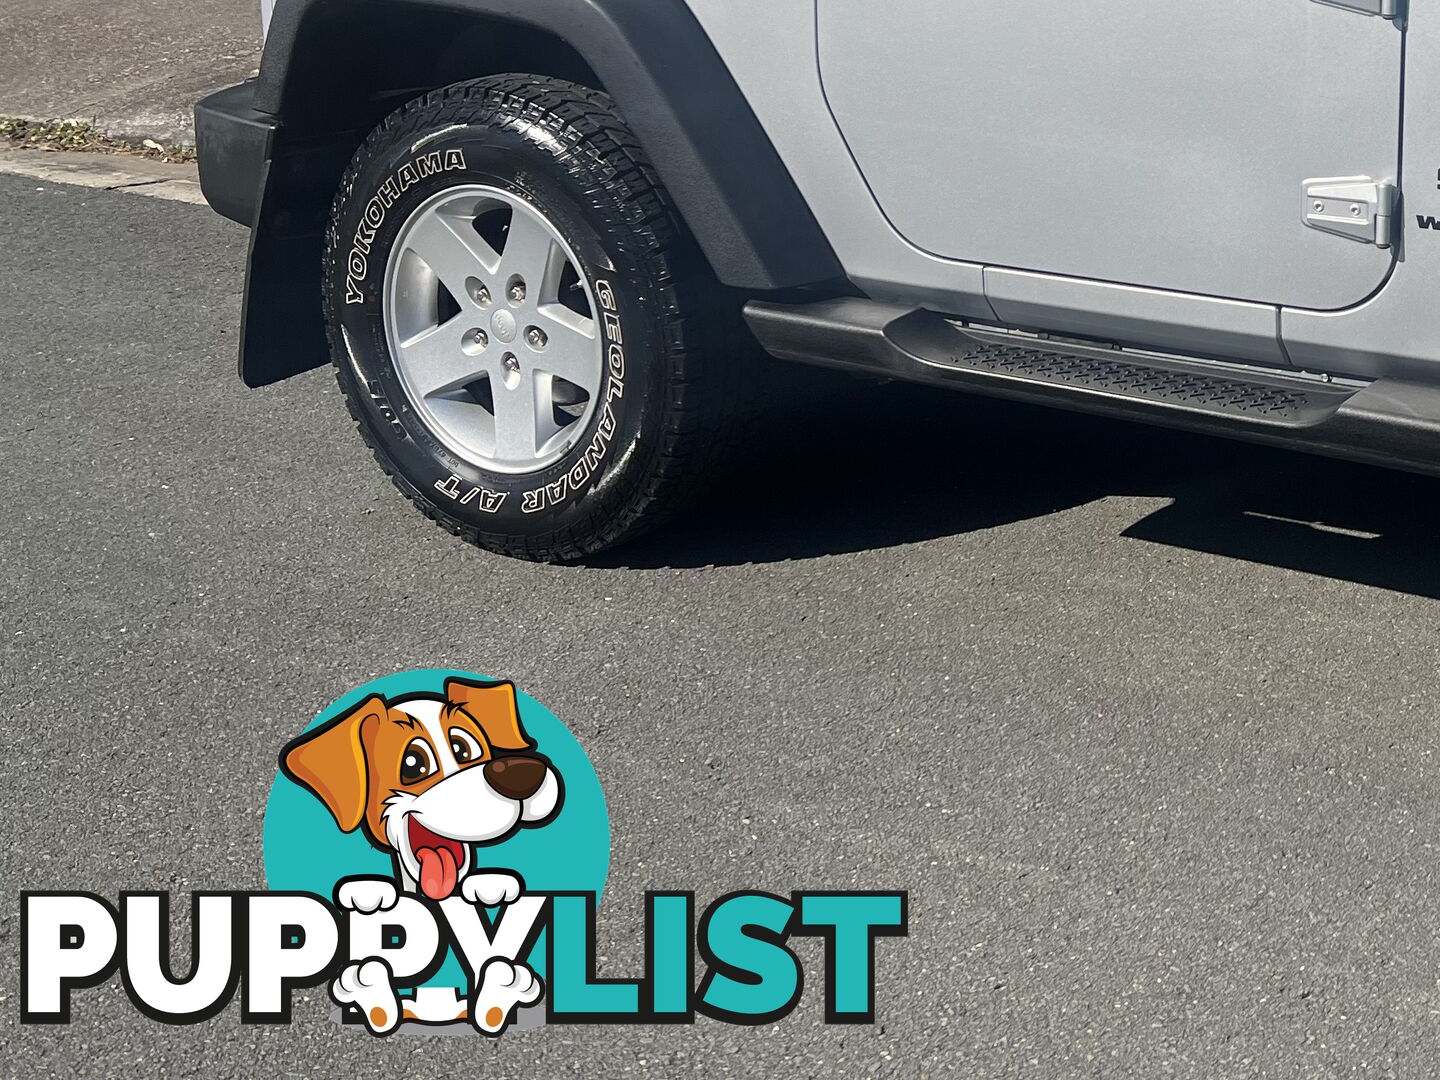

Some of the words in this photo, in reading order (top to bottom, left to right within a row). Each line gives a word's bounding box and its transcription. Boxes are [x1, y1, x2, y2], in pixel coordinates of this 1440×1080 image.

[345, 148, 467, 306] YOKOHAMA
[520, 277, 628, 514] GEOLANDAR
[433, 473, 507, 514] A/T
